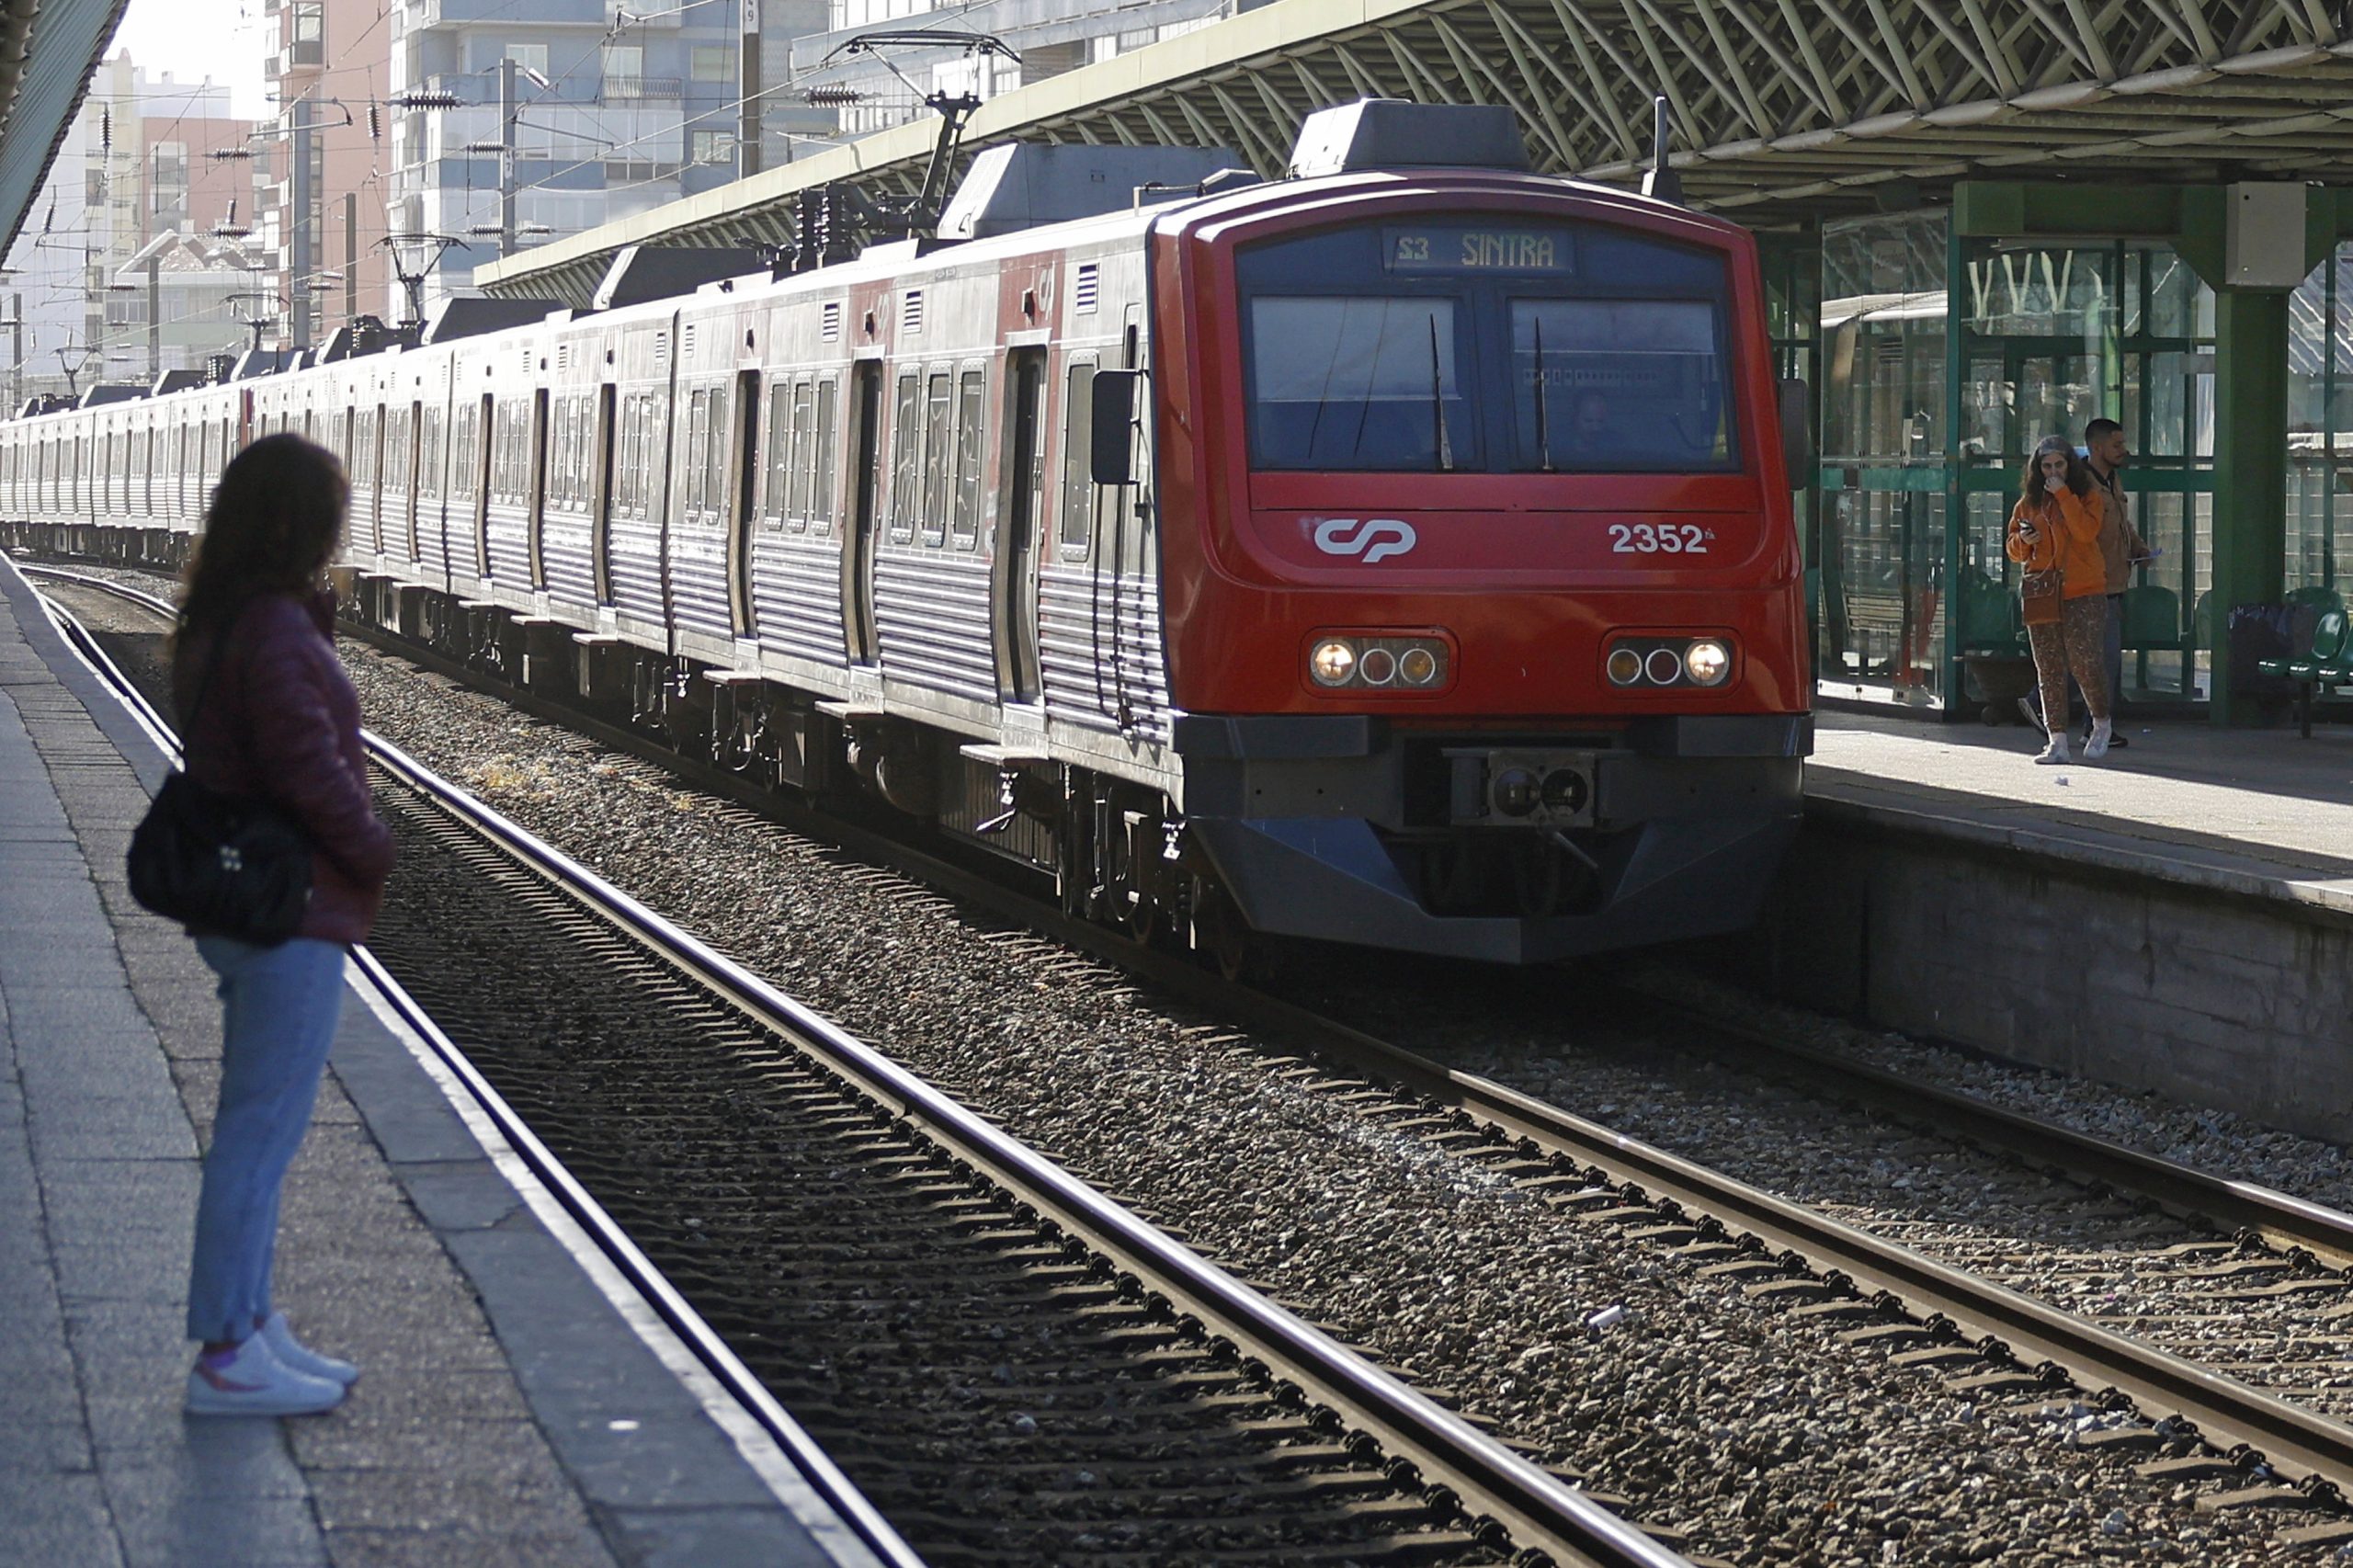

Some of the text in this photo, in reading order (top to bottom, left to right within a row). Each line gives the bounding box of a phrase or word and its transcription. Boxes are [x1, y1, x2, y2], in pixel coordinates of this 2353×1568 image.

[1398, 233, 1554, 267] S3 SINTRA
[1314, 519, 1416, 562] CP
[1608, 524, 1708, 552] 2352
